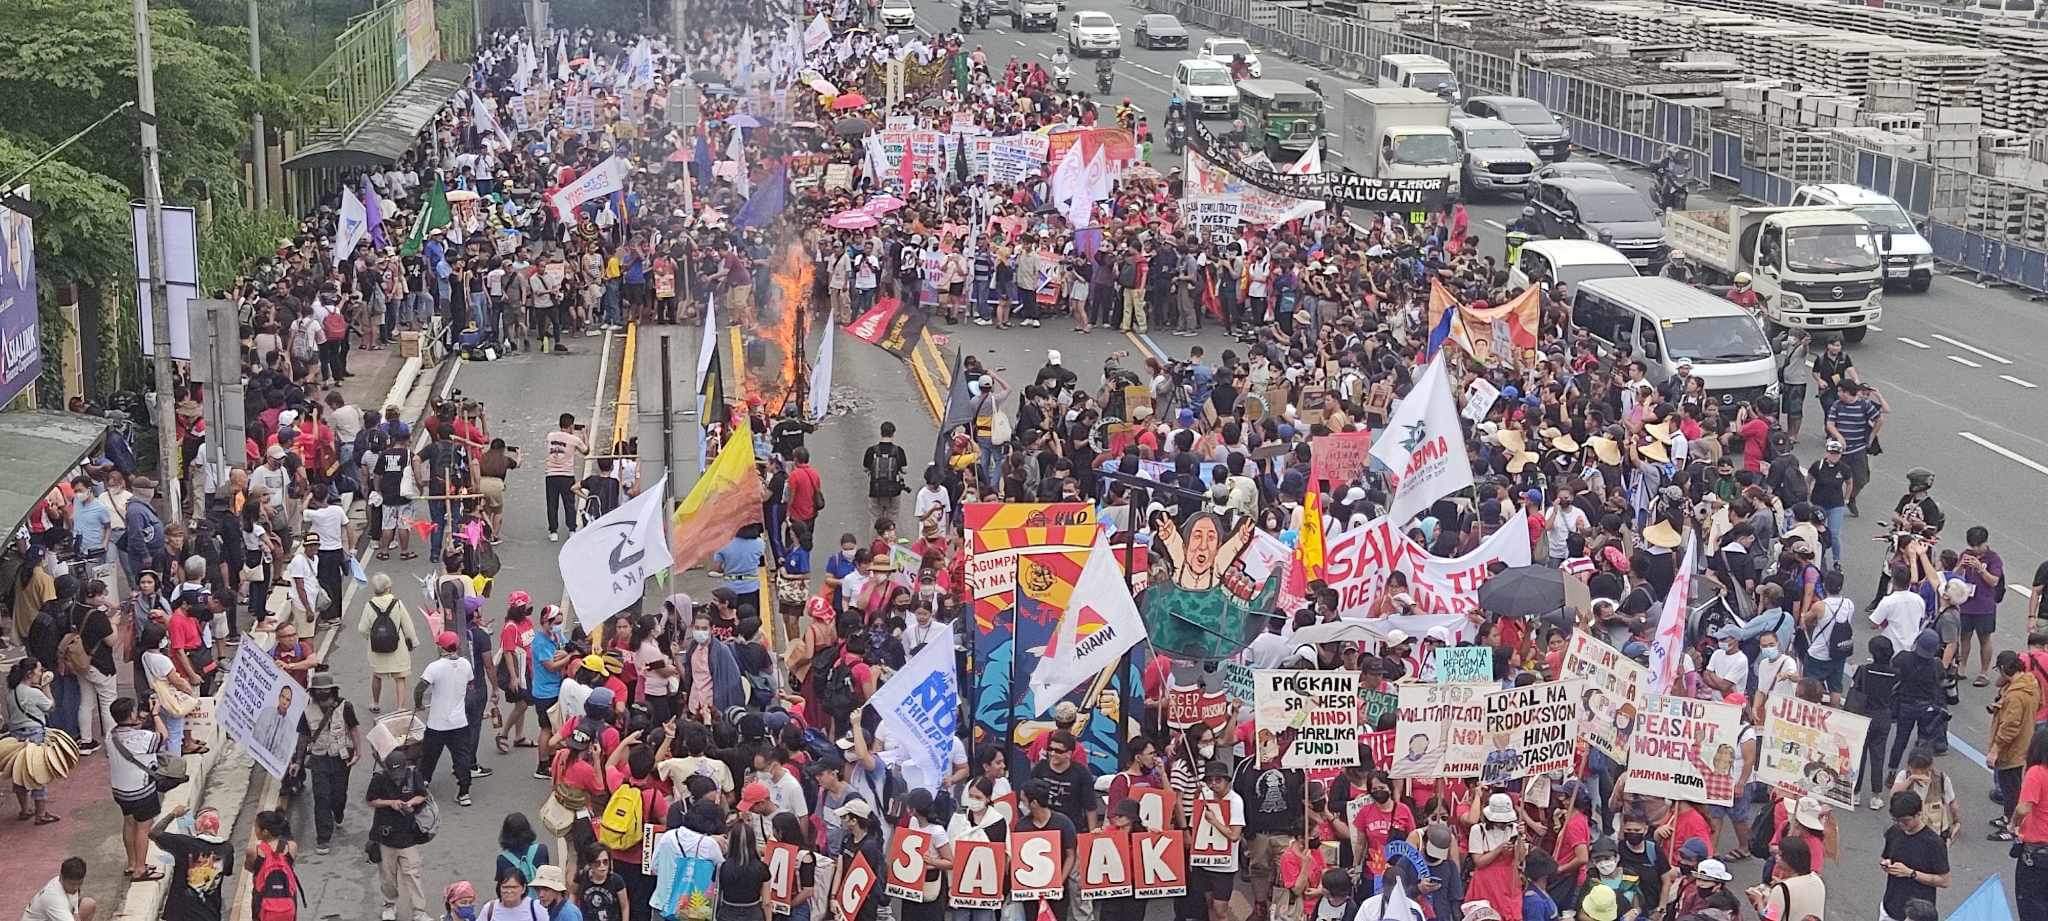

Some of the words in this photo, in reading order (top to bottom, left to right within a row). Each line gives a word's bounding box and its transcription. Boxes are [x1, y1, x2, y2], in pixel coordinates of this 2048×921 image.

[1389, 178, 1441, 190] TERROR
[1202, 214, 1231, 225] WEST
[1327, 521, 1434, 592] SAVE
[990, 574, 1007, 587] NA
[1341, 576, 1371, 612] ICE
[1477, 648, 1487, 658] NA
[1272, 676, 1352, 692] PAGKAIN
[1427, 687, 1473, 704] STOP
[1285, 697, 1302, 711] SA
[1486, 689, 1540, 714] LOKAL
[1547, 685, 1567, 704] NA
[1638, 695, 1705, 719] DEFEND
[1310, 711, 1352, 726] HINDI
[1486, 703, 1577, 733] PRODUKSYON
[1636, 713, 1720, 743] PEASANT
[1771, 697, 1833, 733] JUNK
[1295, 743, 1339, 755] FUND!
[1453, 727, 1483, 746] NO
[1523, 724, 1566, 747] HINDI
[1634, 735, 1690, 761] WOMEN
[1443, 762, 1479, 772] AMIHA
[1480, 739, 1575, 782] IMPORTASYON
[1528, 760, 1569, 775] AMIHAN
[1194, 802, 1229, 851] A
[769, 847, 790, 898] A
[892, 834, 924, 884] S
[959, 846, 998, 896] A
[1014, 837, 1055, 888] S
[1087, 837, 1125, 885] A
[1141, 835, 1177, 885] K
[843, 867, 869, 914] G
